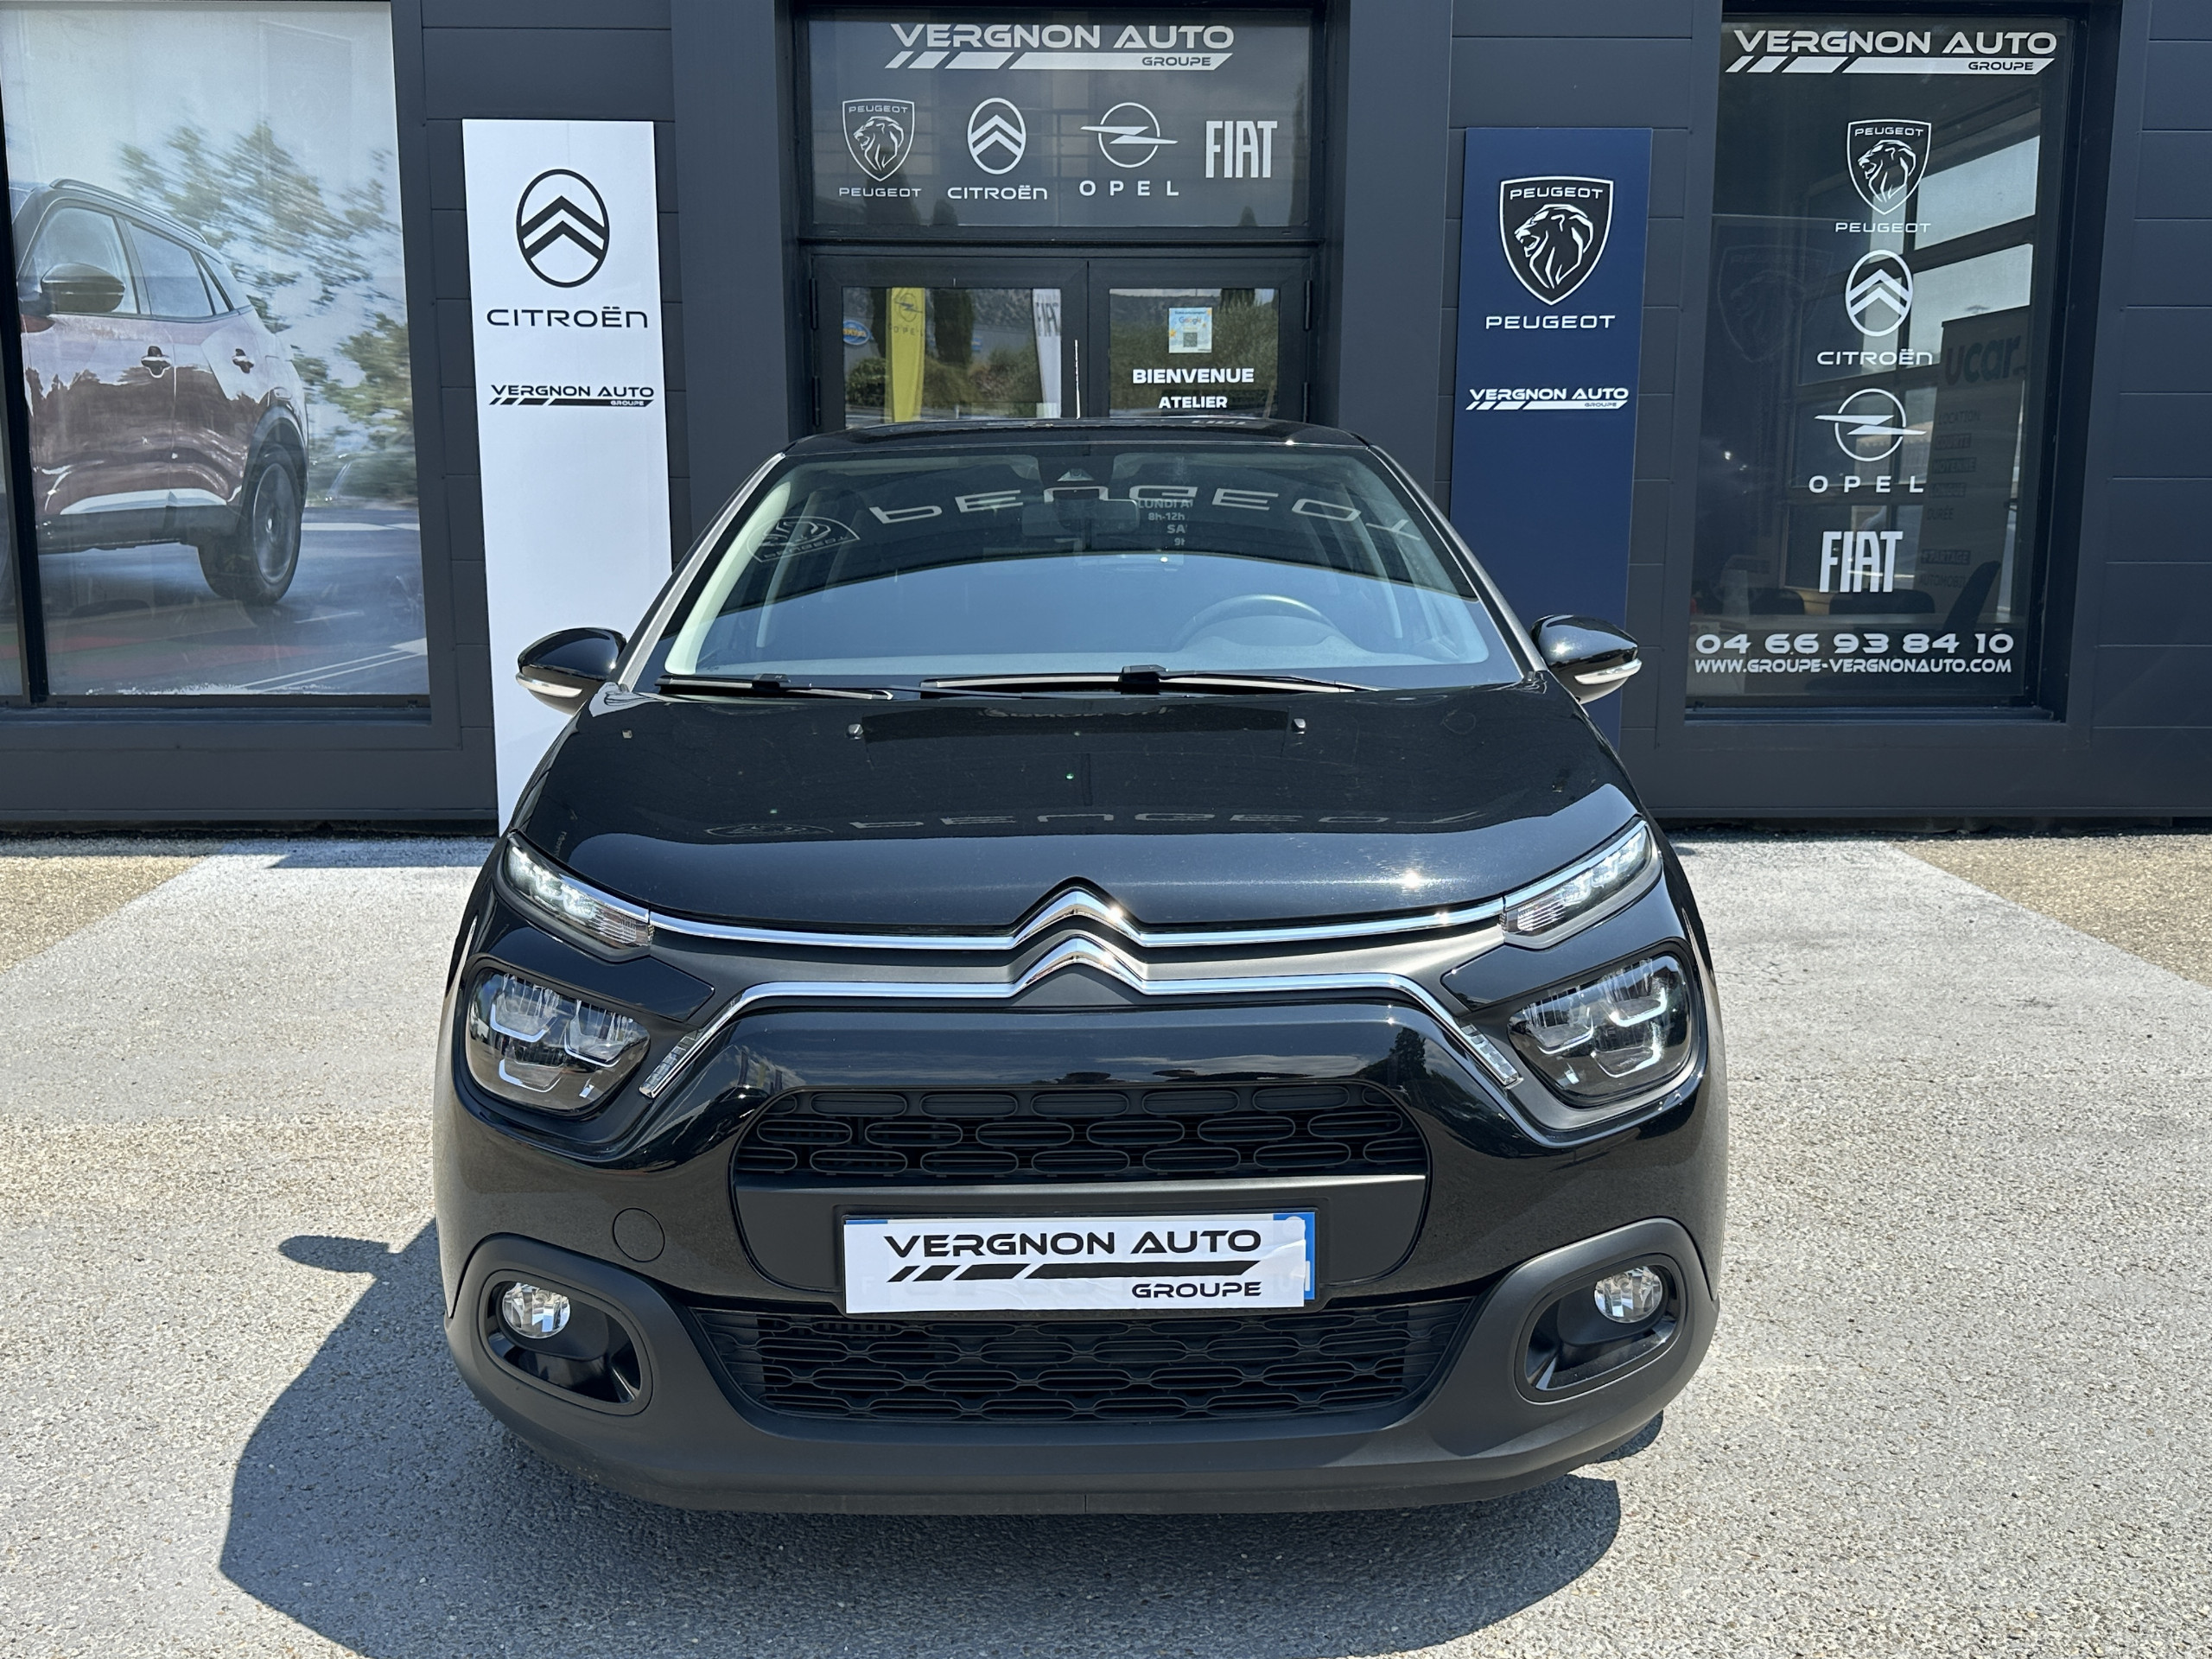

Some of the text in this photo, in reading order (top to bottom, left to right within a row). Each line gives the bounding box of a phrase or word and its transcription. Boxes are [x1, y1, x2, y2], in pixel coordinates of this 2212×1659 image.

[891, 24, 1235, 48] VERGNON AUTO
[1734, 29, 2057, 54] VERGNON AUTO
[1141, 56, 1211, 67] GROUPE
[1967, 61, 2034, 71] GROUPE
[849, 105, 908, 113] PEUGEOT
[1855, 126, 1923, 137] PEUGEOT
[1205, 121, 1277, 178] FIAT
[839, 188, 922, 198] PEUGEOT
[947, 185, 1048, 200] CITROËN
[1079, 181, 1179, 196] OPEL
[1510, 187, 1603, 200] PEUGEOT
[1835, 222, 1931, 233] PEUGEOT
[486, 306, 648, 328] CITROËN
[1486, 315, 1616, 329] PEUGEOT
[1817, 348, 1932, 365] CITROËN
[1133, 368, 1255, 385] BIENVENUE
[491, 385, 654, 397] VERGNON AUTO
[1470, 388, 1629, 400] VERGNON AUTO
[1159, 396, 1228, 409] ATELIER
[1808, 476, 1924, 493] OPEL
[1819, 531, 1903, 593] FIAT
[1696, 633, 2014, 654] 04 66 93 84 10
[1695, 658, 2012, 674] WWW.GROUPE-VERGNONAUTO.COM
[884, 1230, 1262, 1258] VERGNON AUTO
[1132, 1281, 1262, 1298] GROUPE
